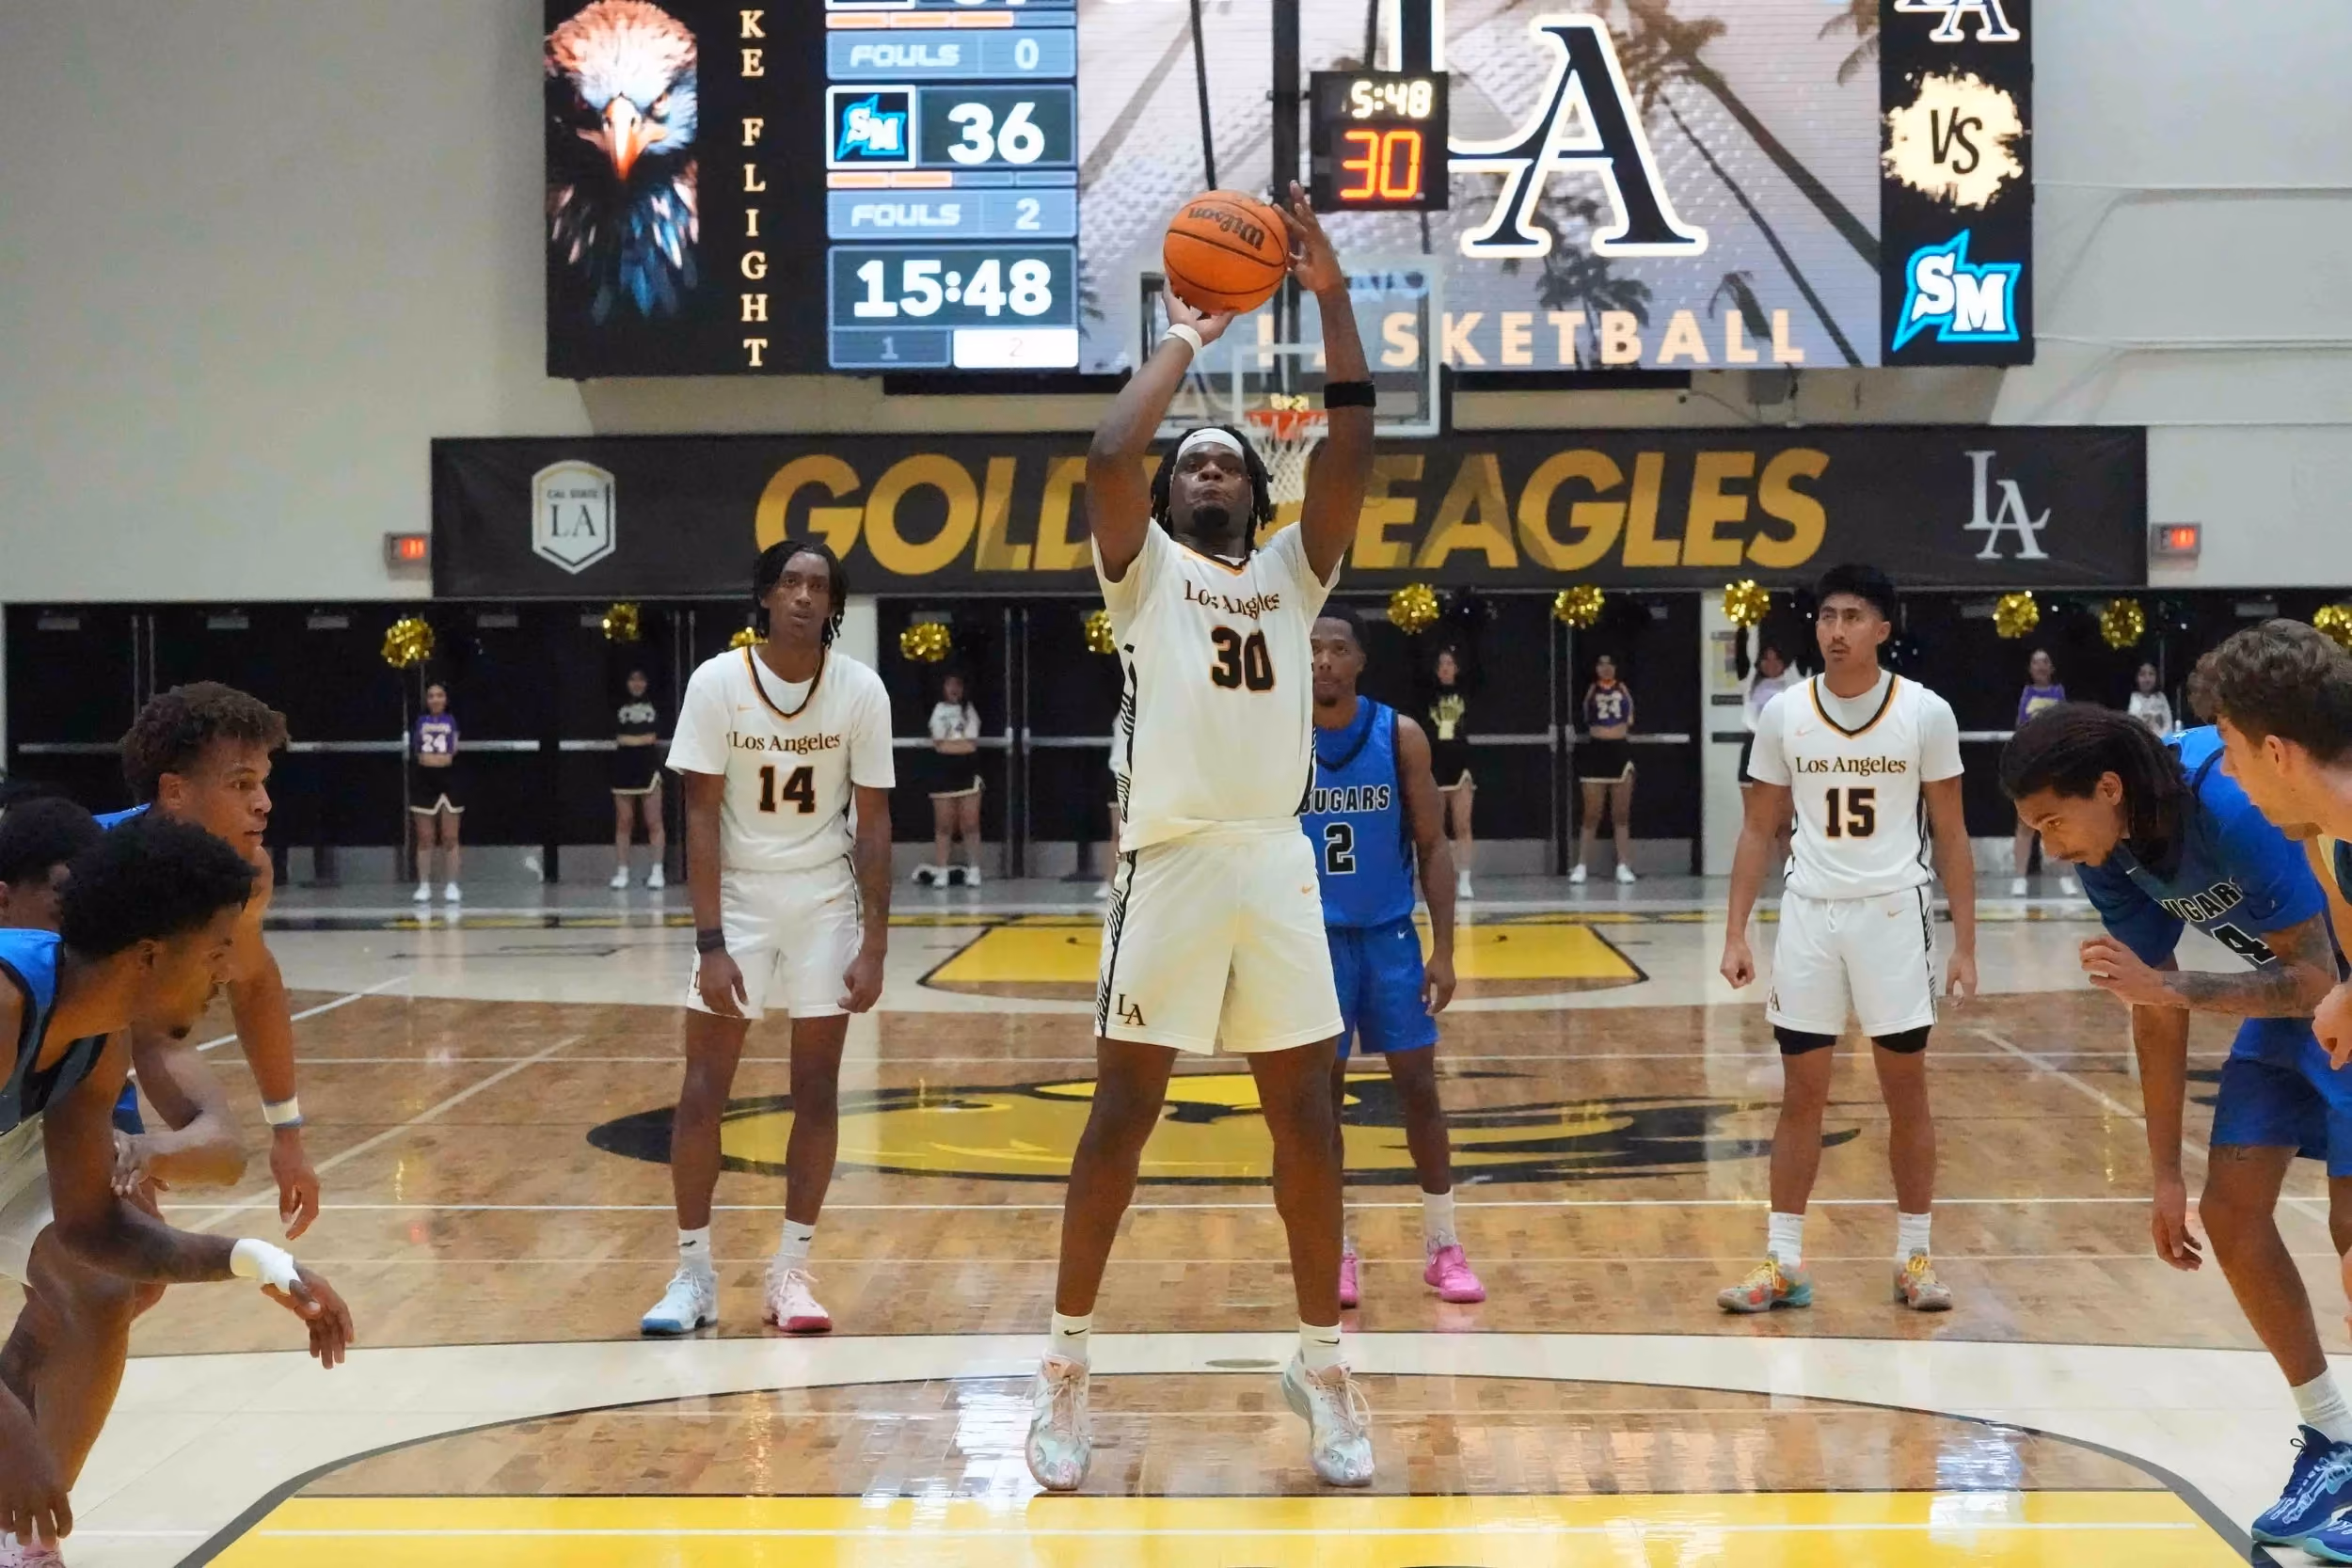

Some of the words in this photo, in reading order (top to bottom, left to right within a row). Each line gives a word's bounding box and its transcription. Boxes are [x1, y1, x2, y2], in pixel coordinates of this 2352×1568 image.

[850, 43, 961, 67] FOULS
[1015, 39, 1040, 70] 0
[1350, 80, 1433, 119] 5:48
[847, 105, 900, 151] SM
[946, 102, 1045, 165] 36
[1930, 107, 1982, 175] VS
[1339, 128, 1424, 200] 30
[851, 203, 961, 226] FOULS
[1015, 198, 1041, 230] 2
[739, 119, 768, 367] FLIGHT
[853, 259, 1052, 317] 15:48
[1910, 251, 2008, 333] SM
[881, 338, 899, 359] 1
[1009, 337, 1025, 357] 2
[1258, 309, 1804, 368] SKETBALL
[550, 504, 597, 537] LA
[1351, 448, 1831, 569] EAGLES
[1963, 451, 2052, 559] LA
[1184, 579, 1219, 610] Los
[1222, 592, 1280, 621] Angles
[1210, 625, 1277, 694] 30
[732, 731, 765, 751] Los
[769, 733, 841, 755] Angeles
[1795, 756, 1829, 773] Los
[1832, 755, 1907, 777] Angeles
[758, 765, 816, 814] 14
[1300, 784, 1391, 815] UGARS
[1825, 787, 1876, 838] 15
[1324, 821, 1356, 876] 2
[2210, 922, 2278, 965] 4
[1116, 993, 1147, 1026] LA
